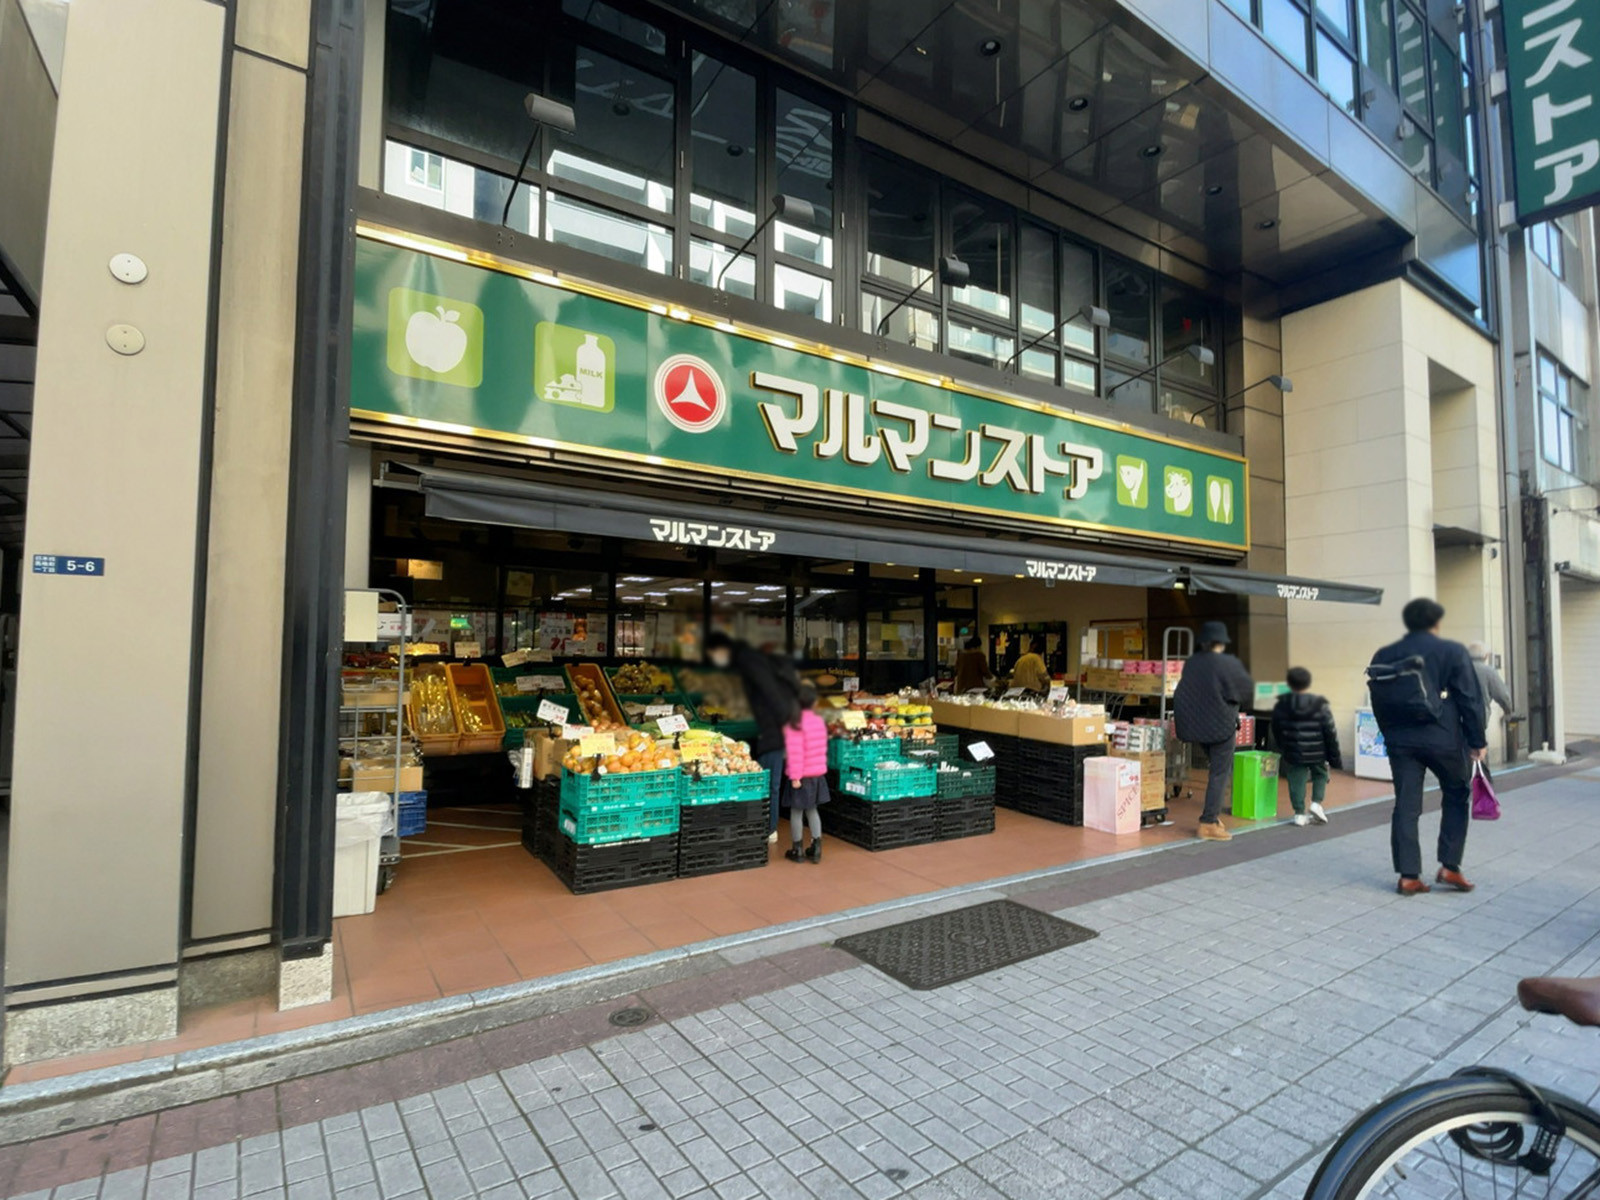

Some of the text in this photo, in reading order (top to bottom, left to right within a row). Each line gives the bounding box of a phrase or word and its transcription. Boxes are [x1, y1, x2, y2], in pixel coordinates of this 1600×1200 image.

[580, 368, 603, 379] MILK
[750, 371, 1103, 500] マルマンストア
[650, 518, 776, 551] マルマンストア
[66, 560, 95, 572] 5-6
[1026, 560, 1096, 582] マルマンストア
[1277, 584, 1319, 601] マルマンストア
